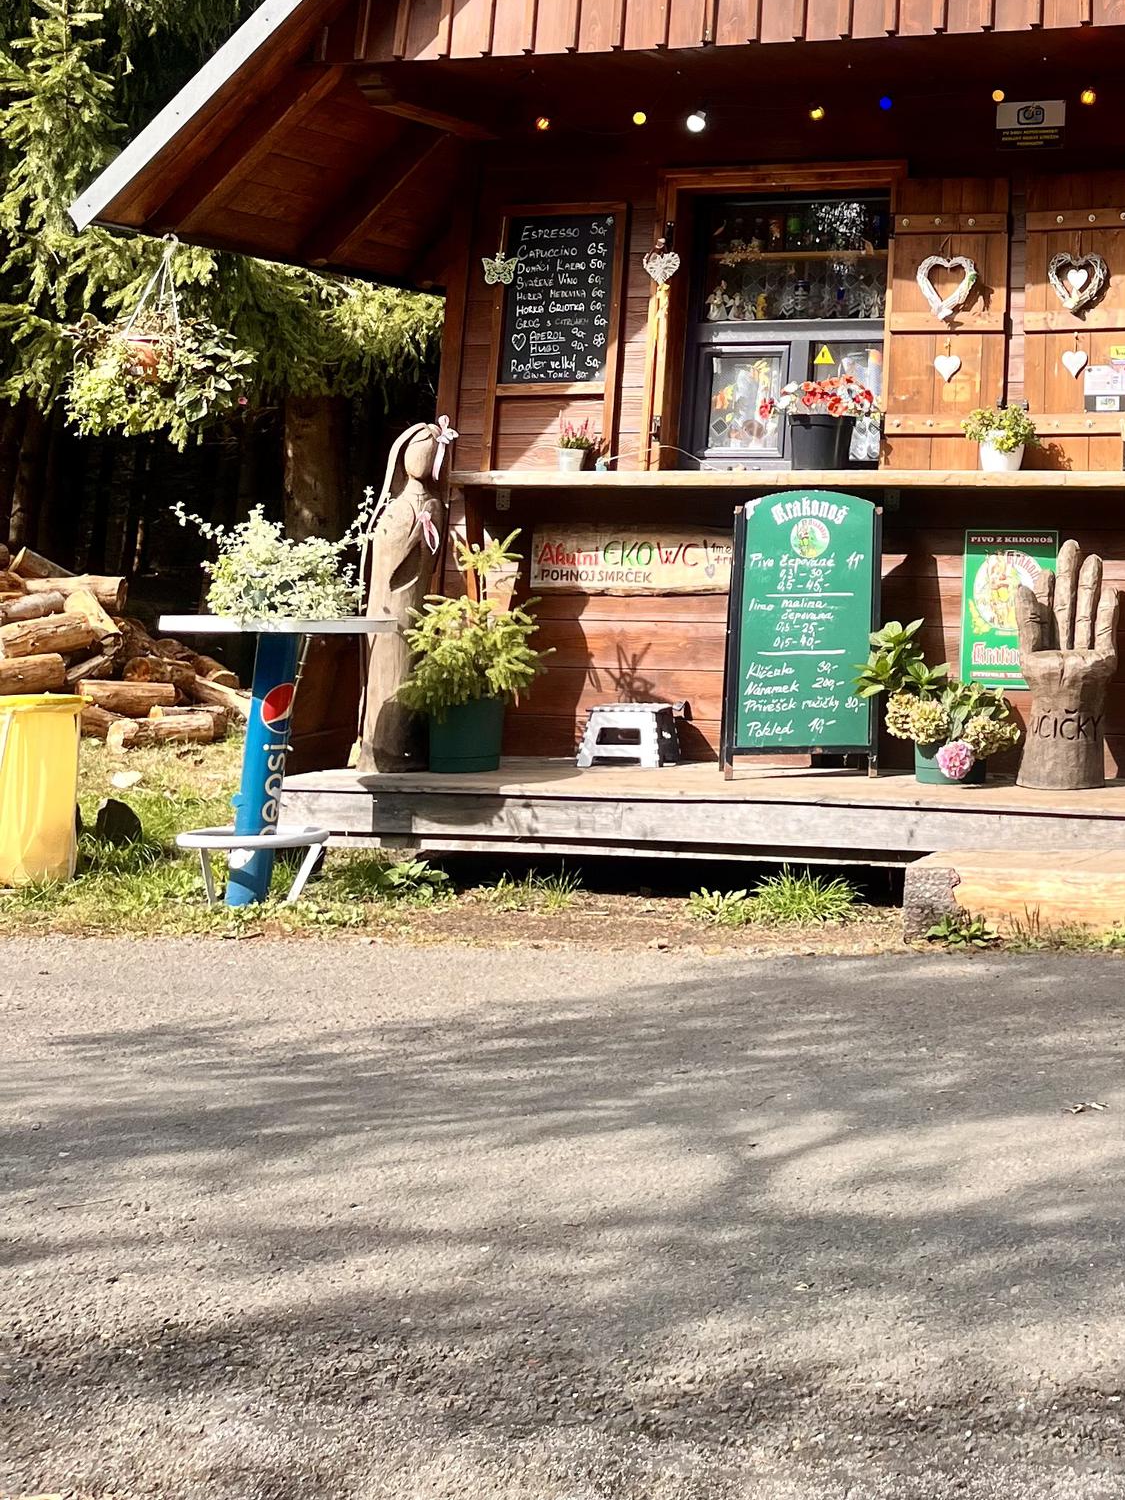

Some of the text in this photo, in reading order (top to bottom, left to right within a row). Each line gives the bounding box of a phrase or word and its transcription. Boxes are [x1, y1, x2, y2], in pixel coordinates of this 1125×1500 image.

[521, 225, 580, 241] ESPRESSO
[516, 301, 546, 317] HORKÁ
[515, 318, 541, 330] GROG
[529, 330, 566, 342] APEROL
[511, 357, 547, 373] Radler
[550, 354, 576, 371] velký
[771, 497, 850, 525] Krakonoš
[603, 541, 654, 567] EKO
[750, 553, 775, 568] Pivo
[780, 552, 836, 574] čepované
[541, 568, 652, 583] POHNOJ SMRČEK
[744, 680, 800, 696] Náramek
